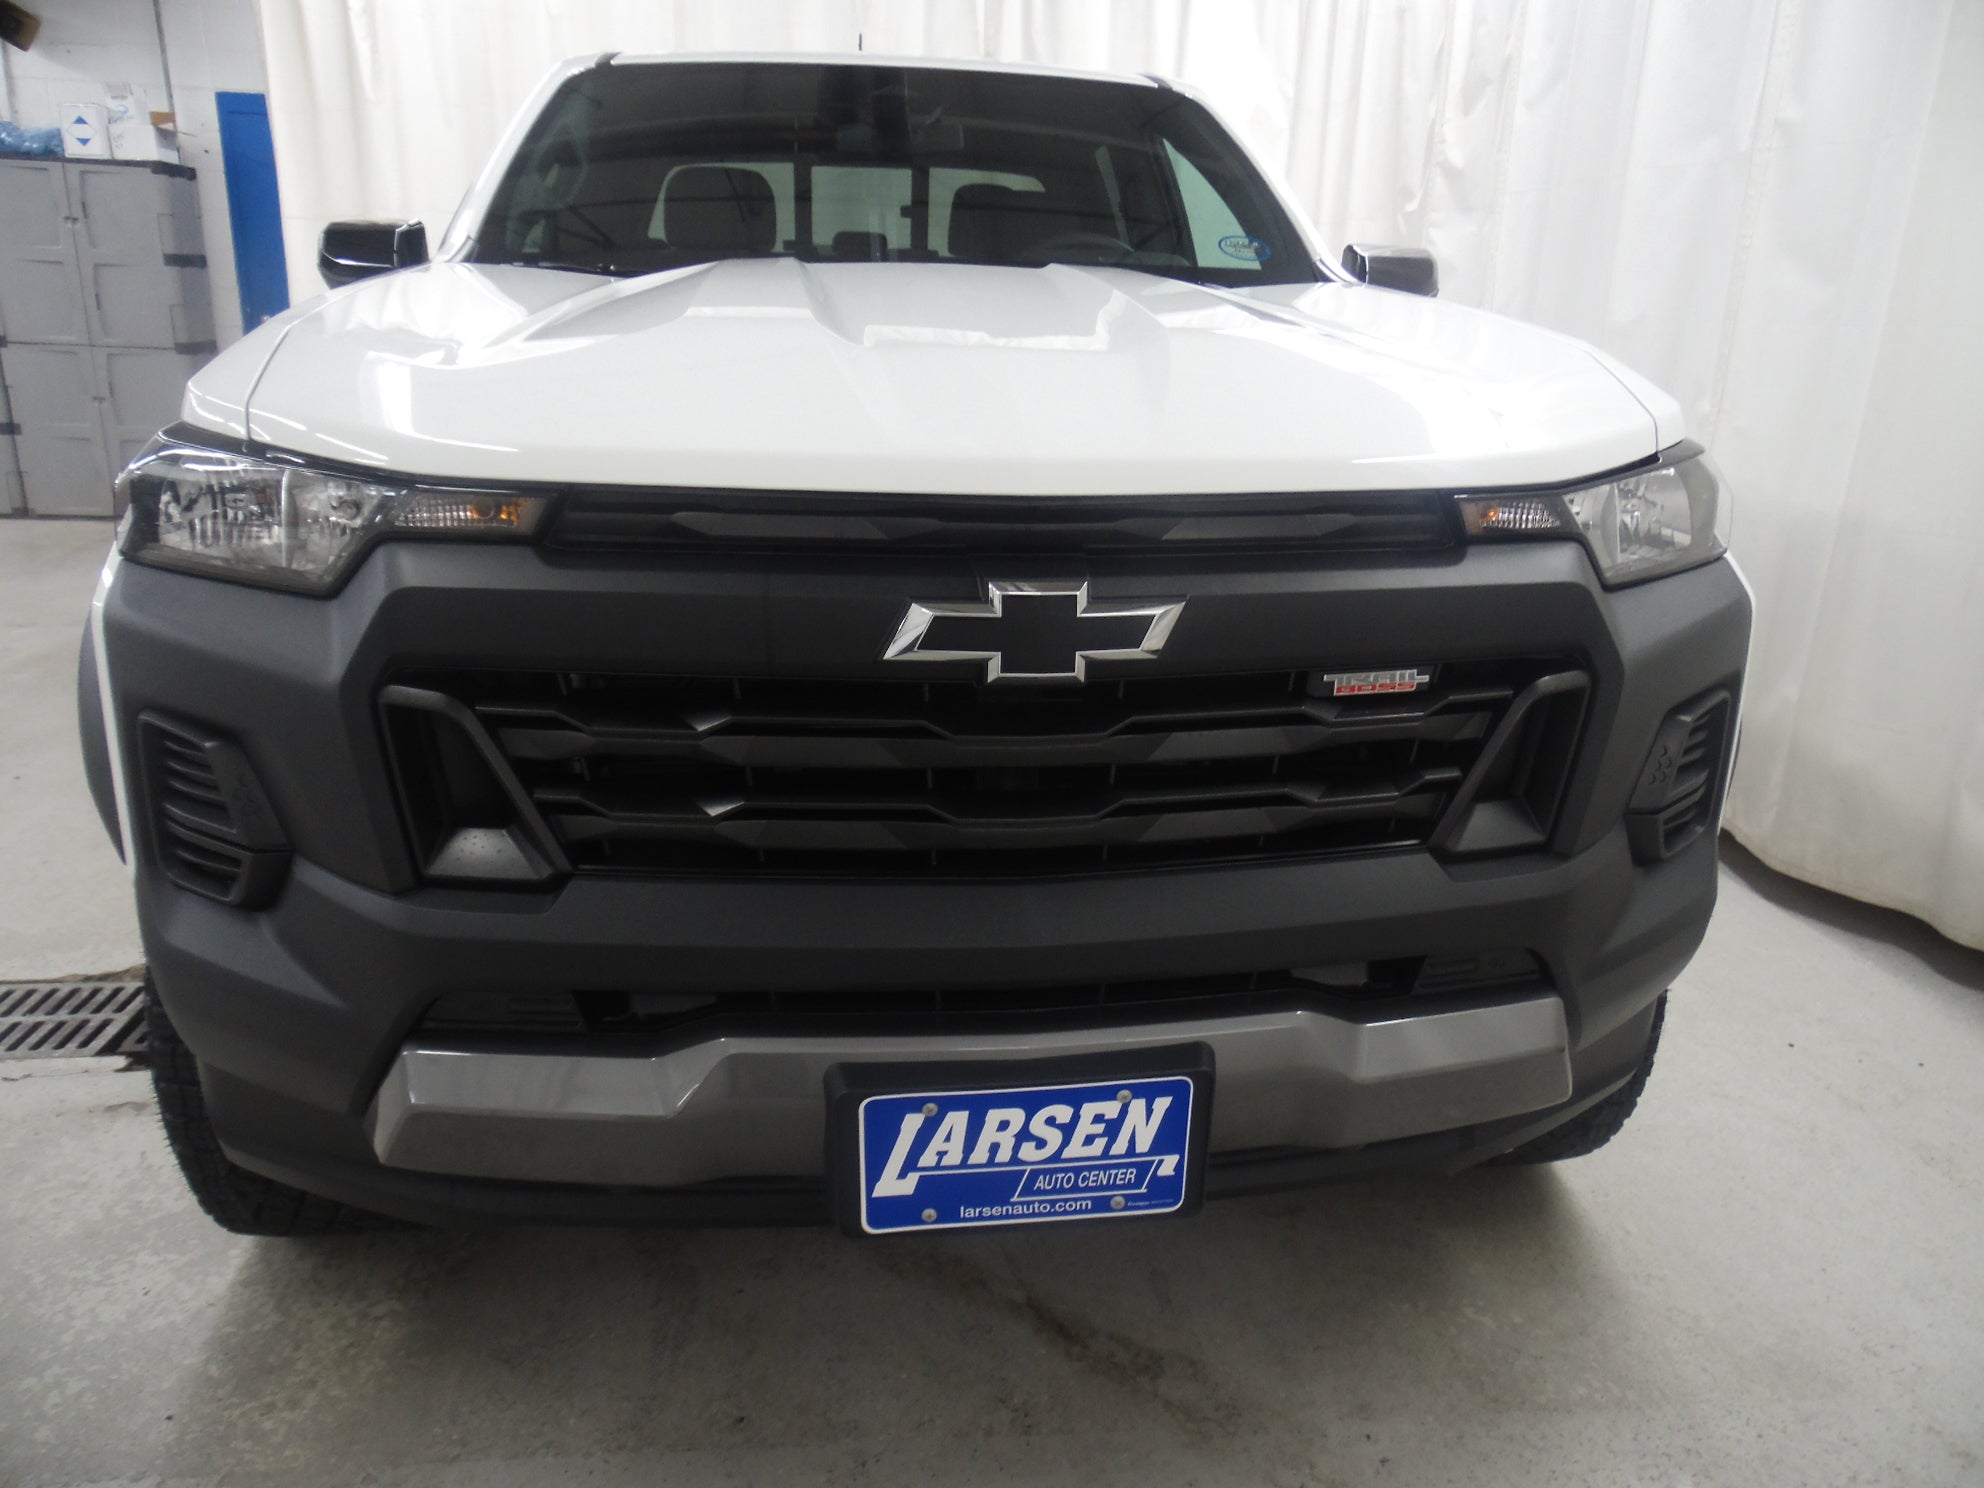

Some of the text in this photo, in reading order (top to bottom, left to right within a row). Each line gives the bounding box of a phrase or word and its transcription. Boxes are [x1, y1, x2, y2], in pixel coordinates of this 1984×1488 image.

[1323, 669, 1429, 686] TRAIL
[1334, 683, 1416, 695] BOSS
[872, 1096, 1178, 1197] LARSEN
[1034, 1169, 1136, 1191] AUTO CENTER
[959, 1198, 1092, 1218] larsenauto.com
